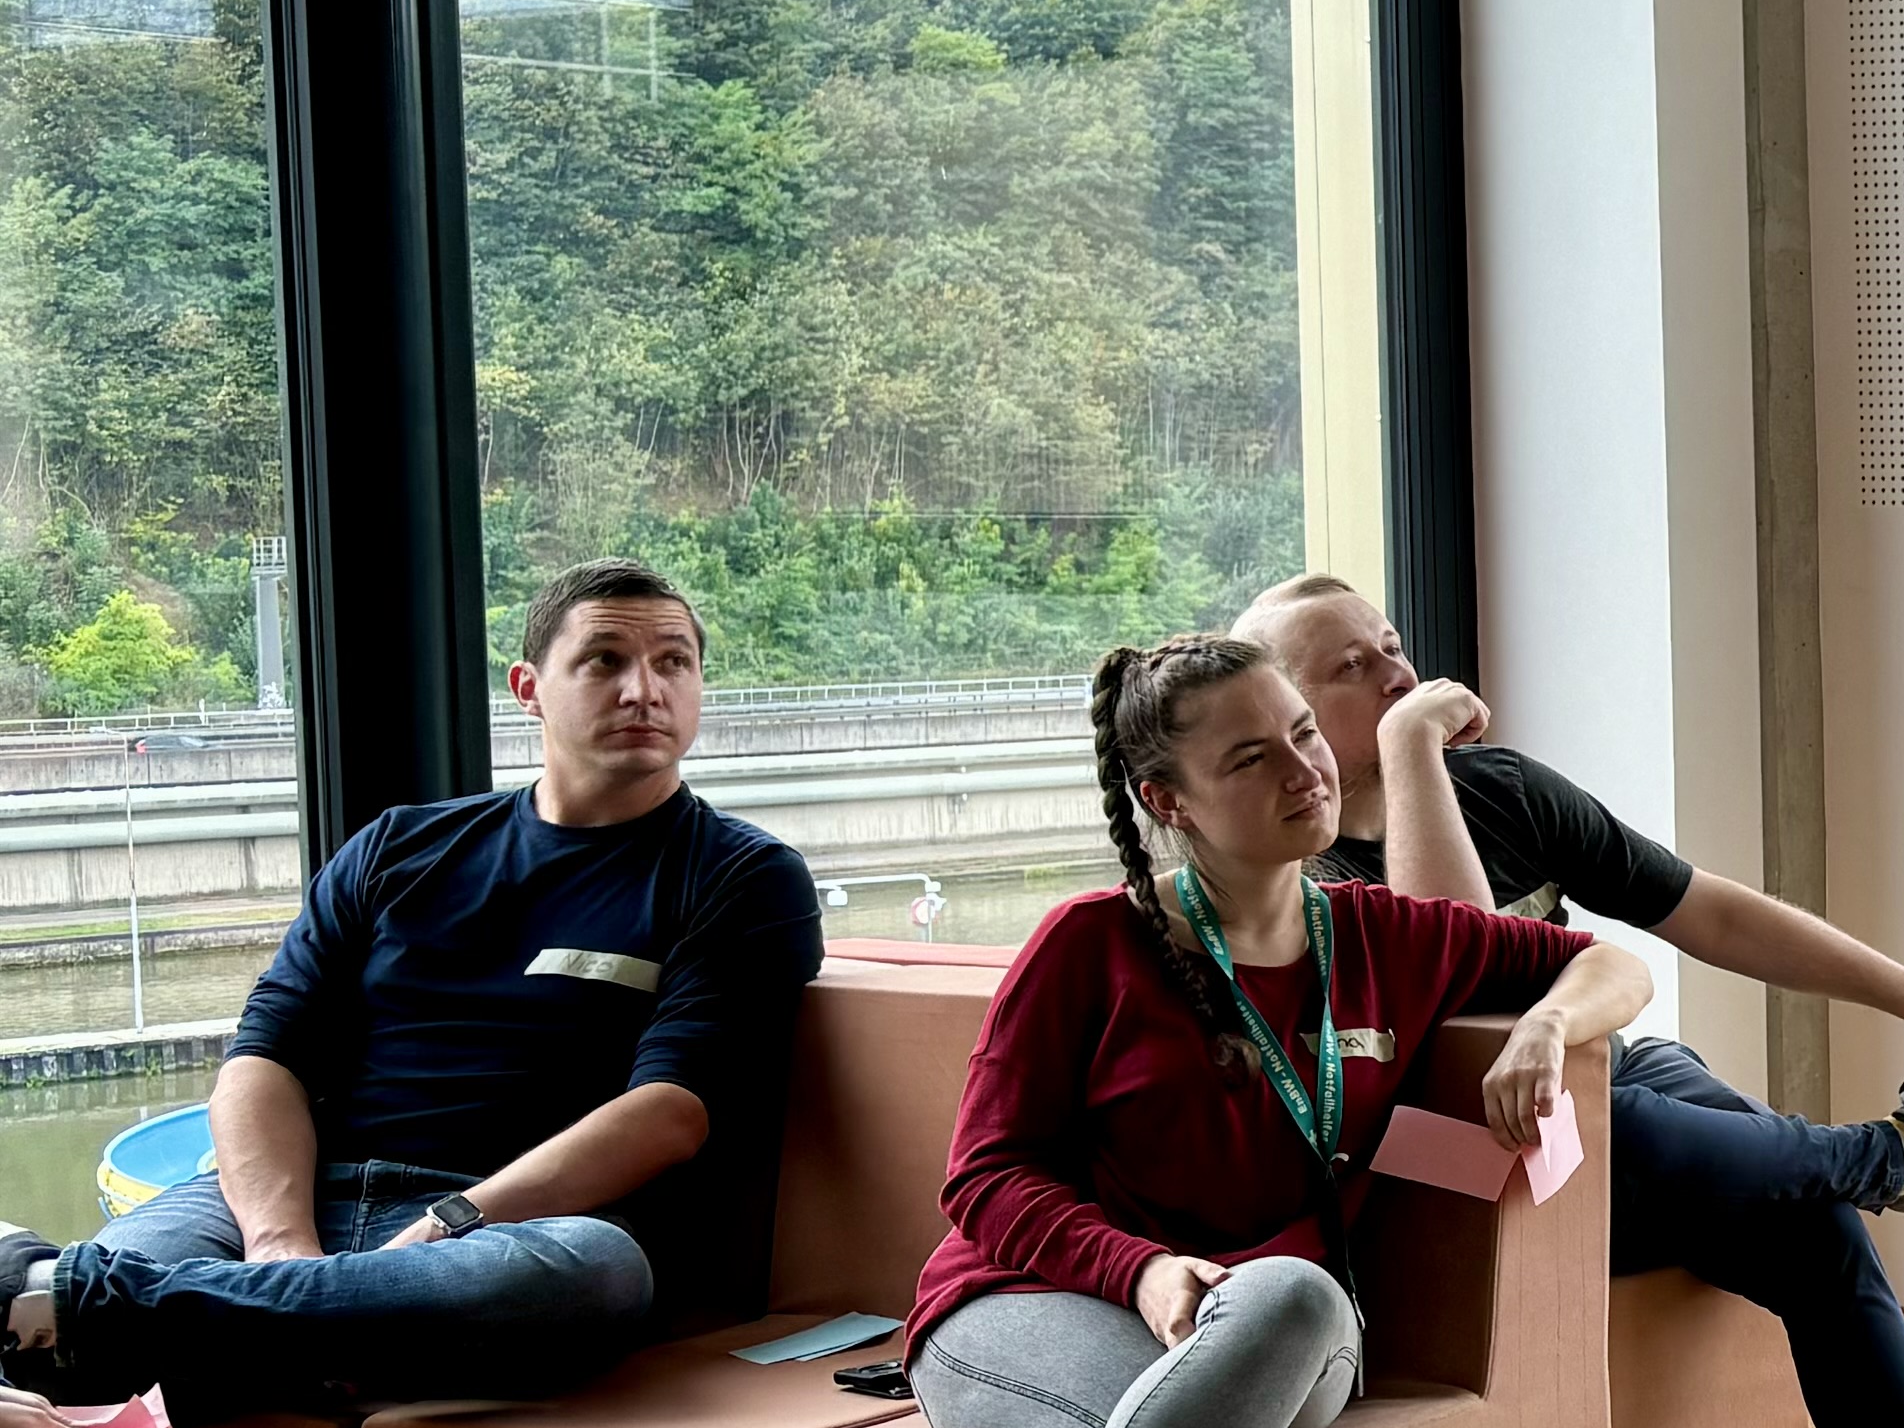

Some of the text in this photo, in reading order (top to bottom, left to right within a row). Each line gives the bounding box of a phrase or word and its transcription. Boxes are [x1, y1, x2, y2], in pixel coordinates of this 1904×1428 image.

[1236, 1000, 1308, 1114] EnBW Notfallhelfer
[1322, 1063, 1336, 1143] Notfallhelfer
